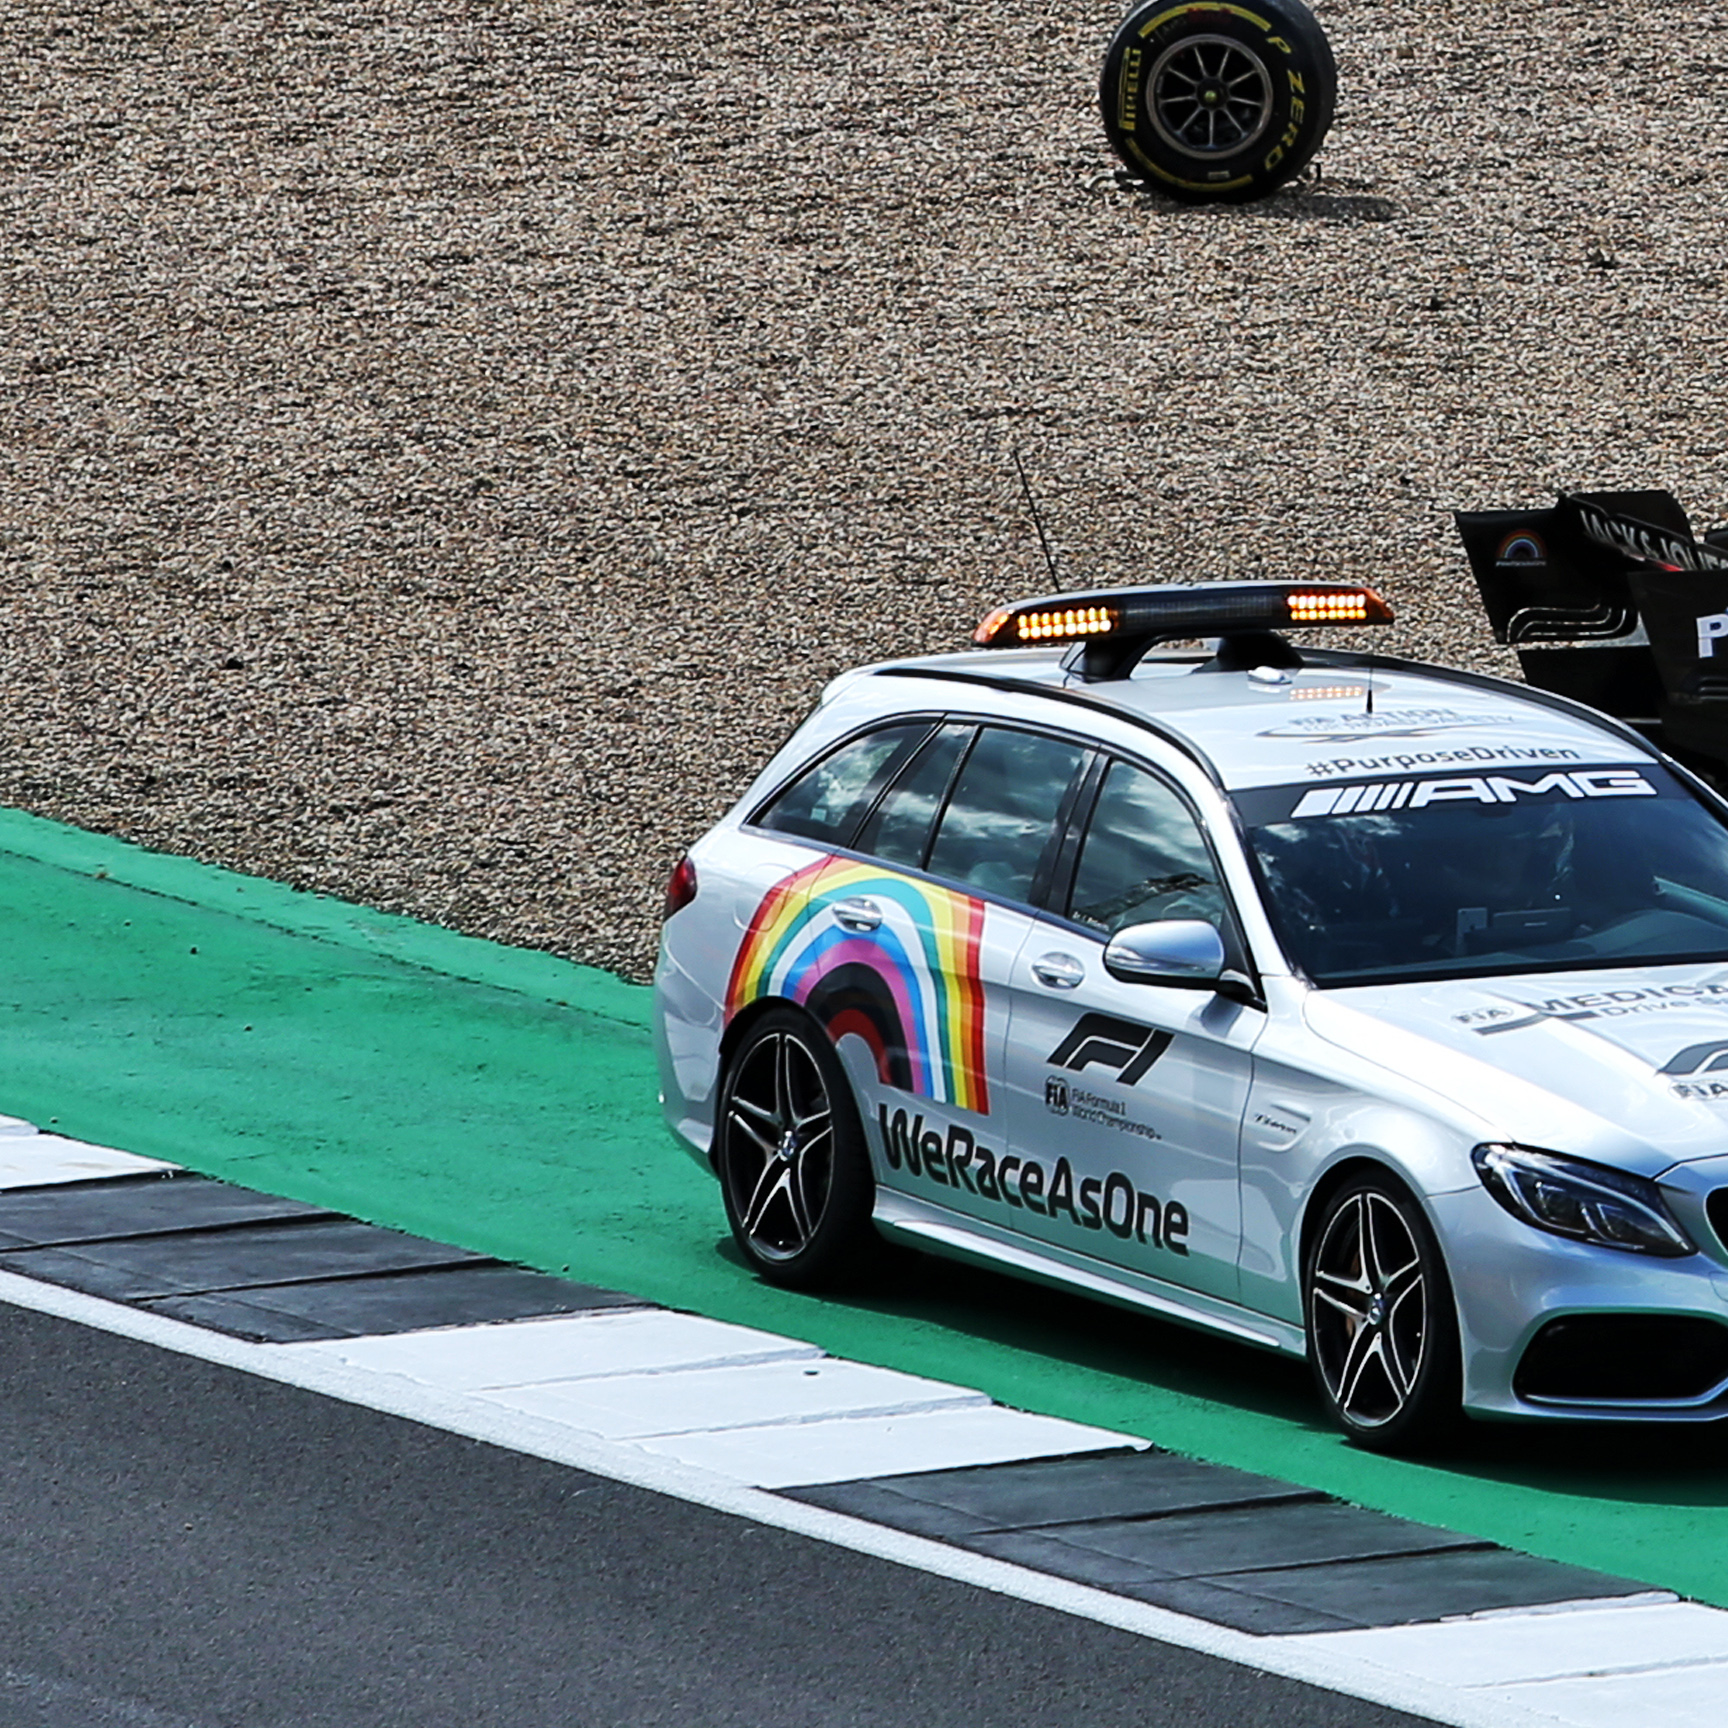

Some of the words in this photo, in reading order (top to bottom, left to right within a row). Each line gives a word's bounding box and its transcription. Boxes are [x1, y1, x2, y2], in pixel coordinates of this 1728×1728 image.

[1266, 36, 1293, 55] P
[1118, 46, 1142, 131] PIRELLI
[1264, 69, 1306, 170] ZERO
[1304, 744, 1581, 778] #PurposeDriven
[1600, 999, 1691, 1018] Drive
[1045, 1081, 1069, 1110] FIA
[879, 1102, 1189, 1256] WeRaceAsOne
